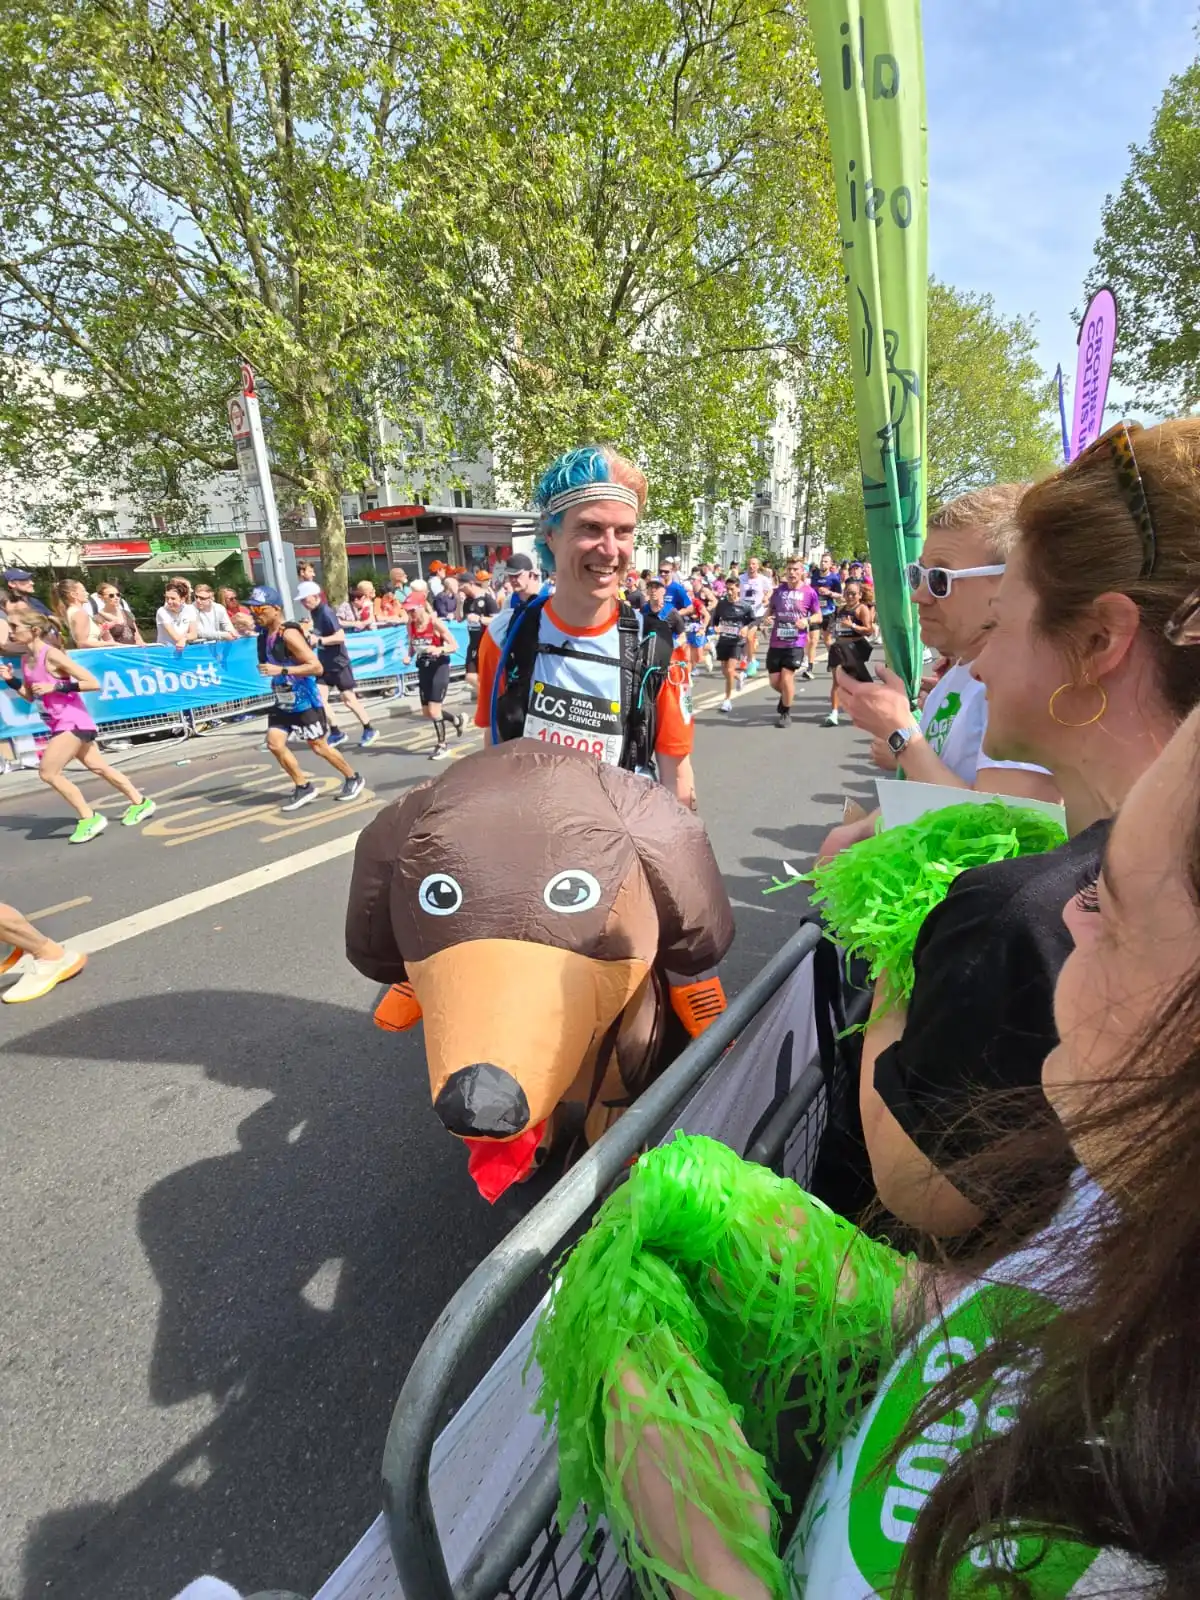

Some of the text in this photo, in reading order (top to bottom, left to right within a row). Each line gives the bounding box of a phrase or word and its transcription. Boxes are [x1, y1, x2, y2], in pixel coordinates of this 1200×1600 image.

[1080, 320, 1096, 424] COLITIS
[98, 662, 222, 700] Abbott
[571, 697, 593, 710] TATA
[567, 713, 601, 728] SERVICES
